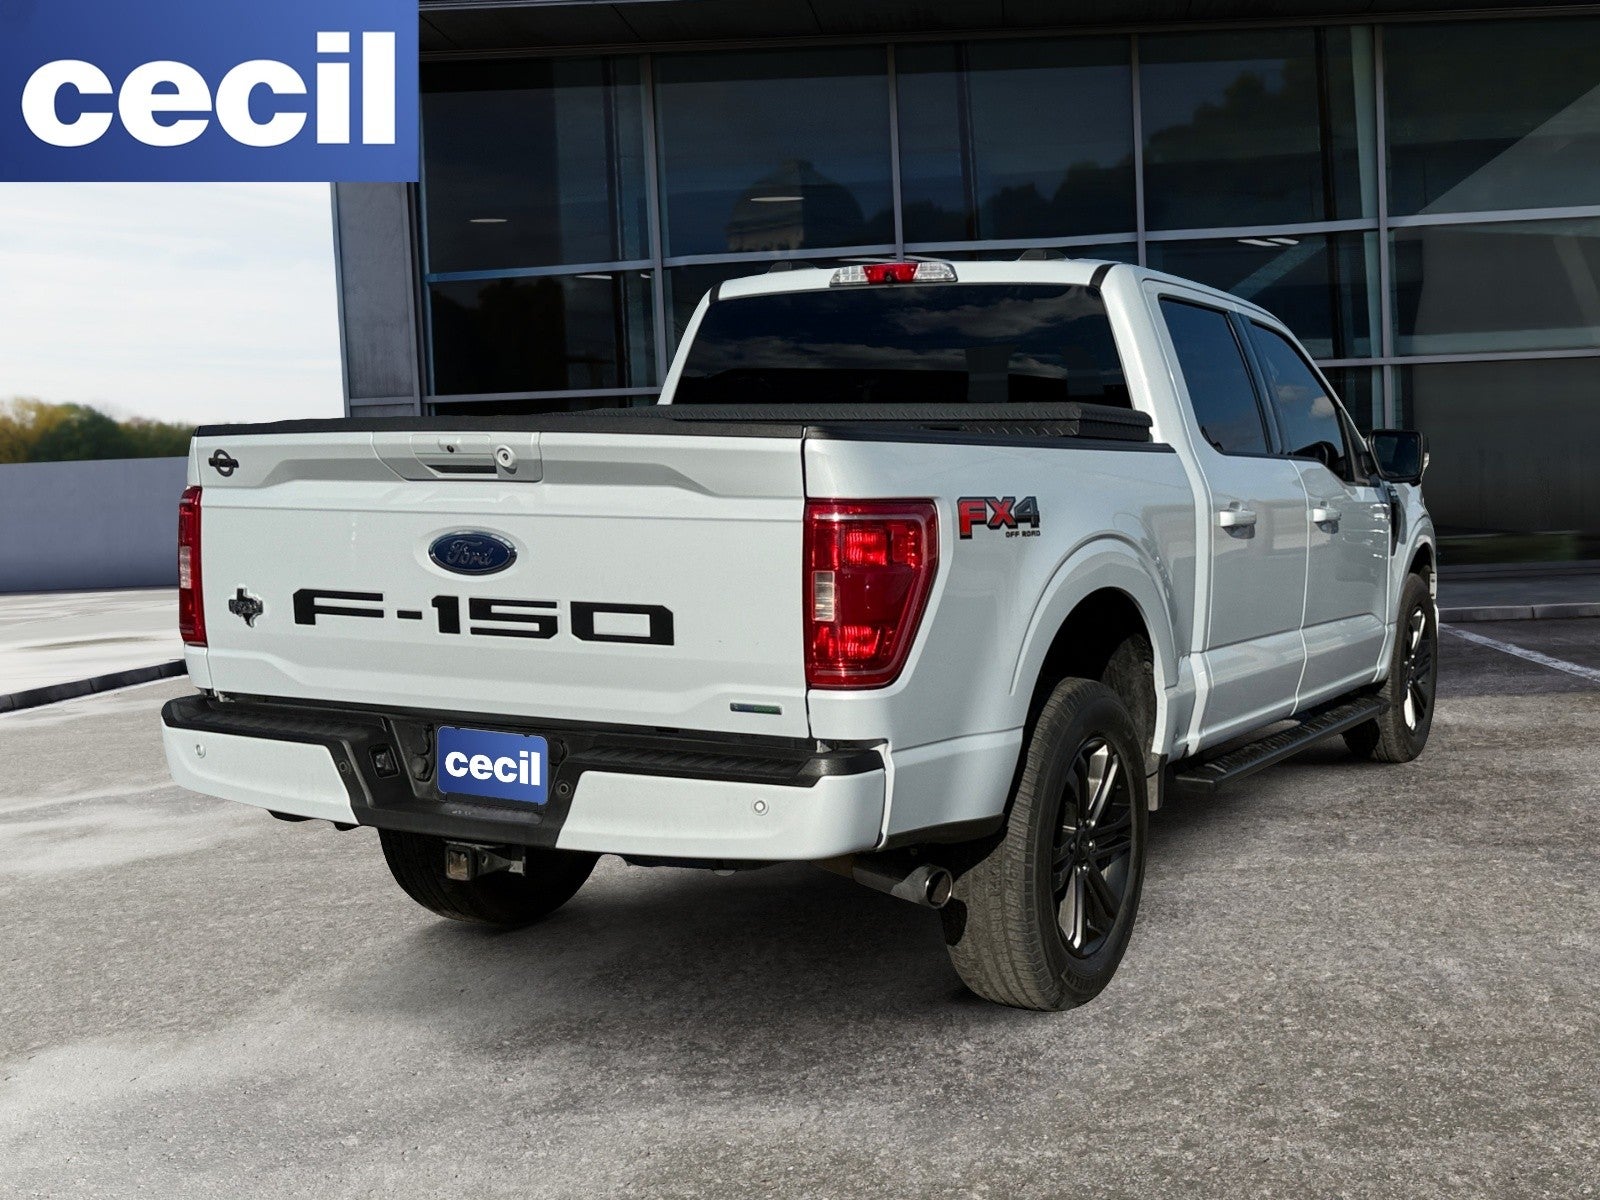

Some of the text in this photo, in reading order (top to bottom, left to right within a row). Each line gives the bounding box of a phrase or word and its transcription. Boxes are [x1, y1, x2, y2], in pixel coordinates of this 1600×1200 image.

[957, 496, 1041, 540] FX4
[1005, 530, 1020, 538] OFF
[446, 540, 494, 566] Ford
[292, 588, 674, 646] F-150
[444, 750, 541, 787] cecil
